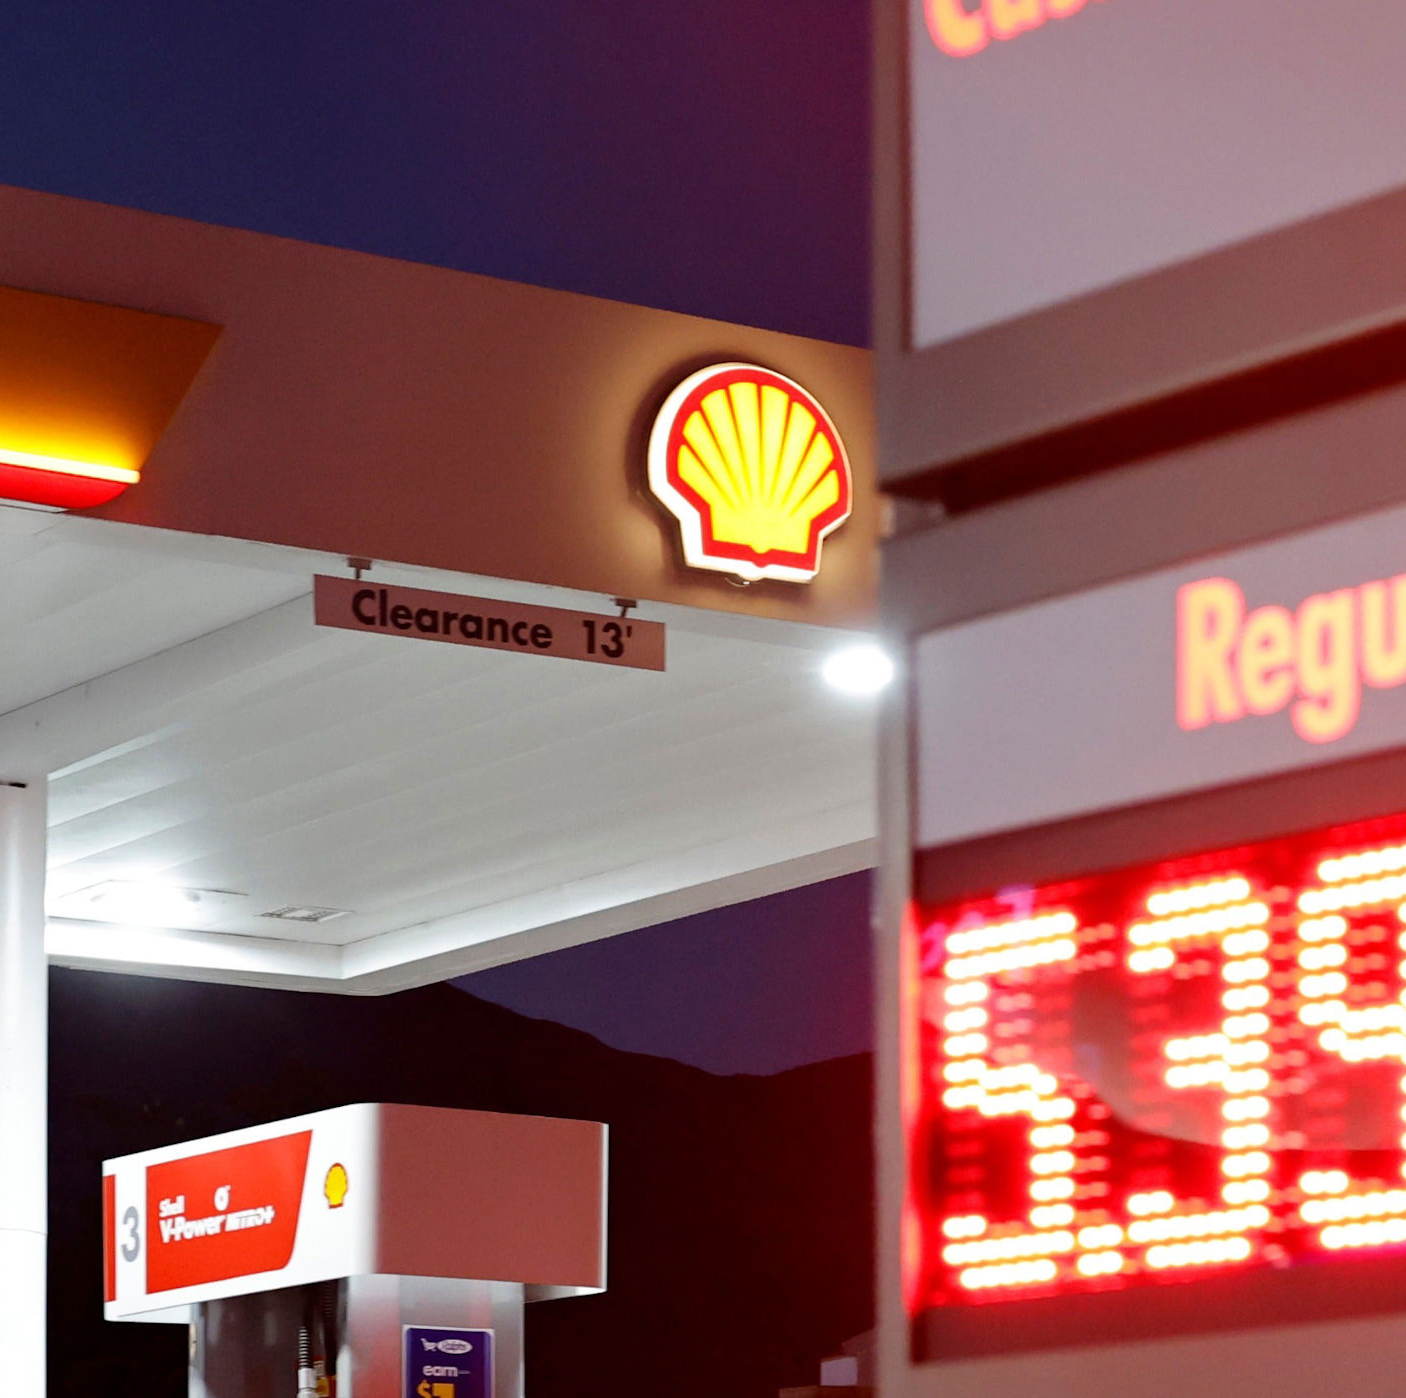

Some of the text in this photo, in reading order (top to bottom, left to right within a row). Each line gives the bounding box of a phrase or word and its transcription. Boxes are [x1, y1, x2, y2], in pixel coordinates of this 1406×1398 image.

[351, 589, 632, 659] Clearance 13'
[121, 1206, 140, 1262] 3
[422, 1365, 458, 1377] earn
